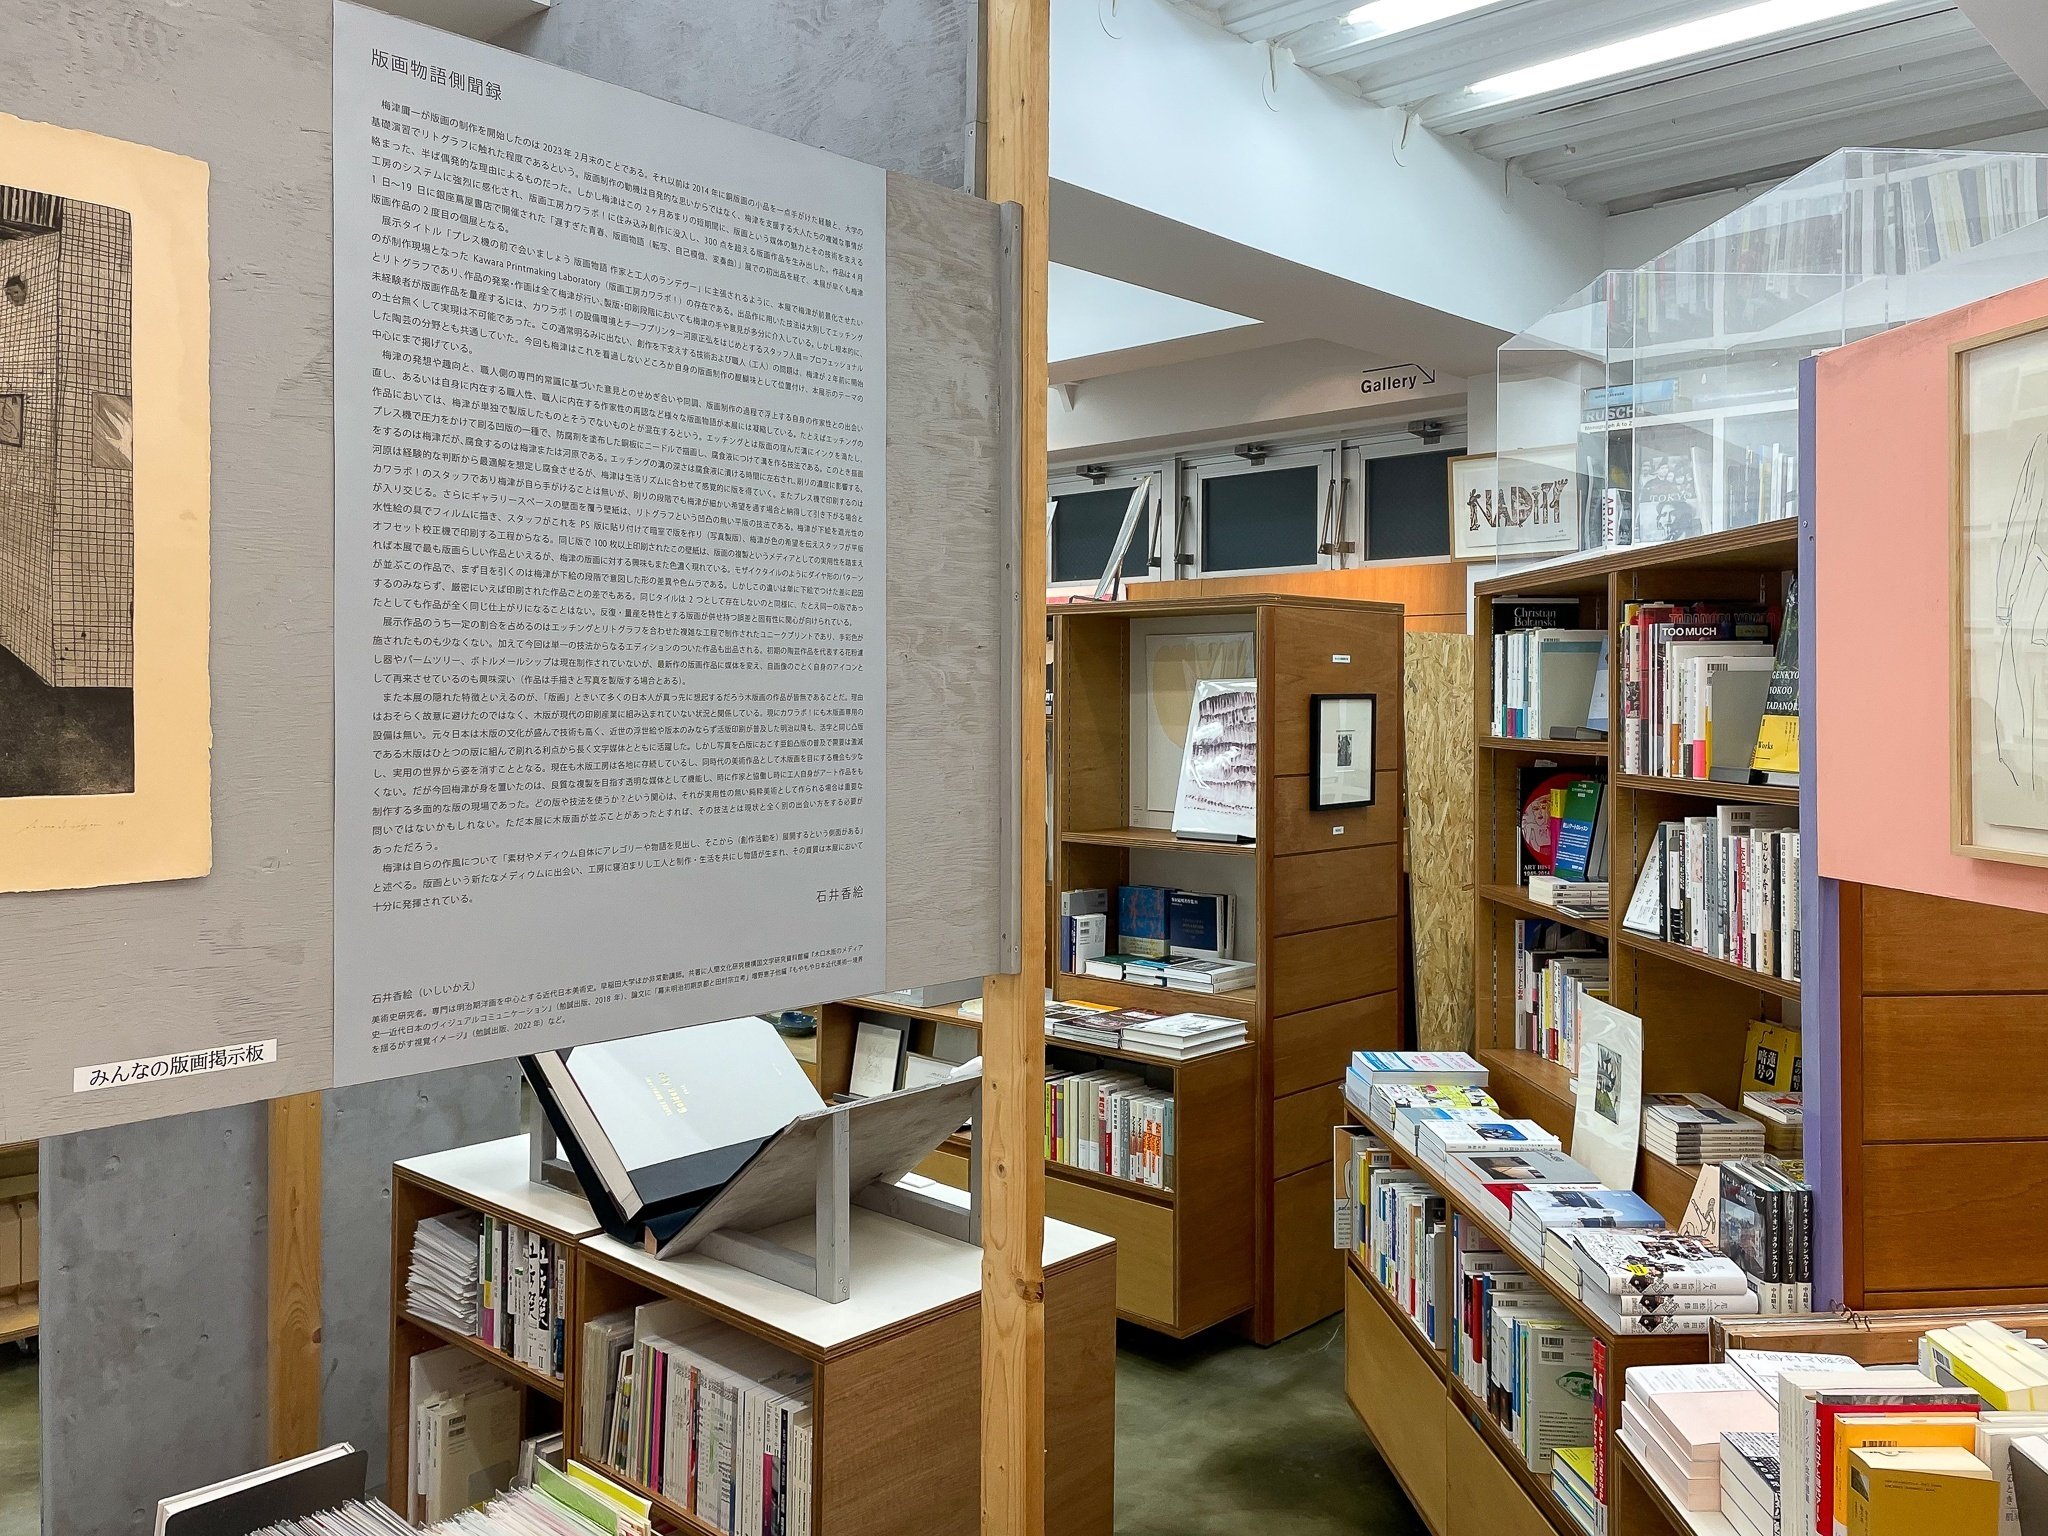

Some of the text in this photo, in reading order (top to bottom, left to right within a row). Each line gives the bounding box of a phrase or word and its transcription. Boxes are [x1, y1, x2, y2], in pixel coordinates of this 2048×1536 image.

[371, 46, 501, 103] 版画物語側聞録
[371, 230, 469, 262] のが制作現場となった
[472, 251, 504, 270] Kawara
[505, 258, 556, 280] Printmaking
[558, 269, 600, 289] Laboratory
[573, 255, 607, 274] 版画物語
[371, 327, 472, 355] 中心にまで掲げている。
[1361, 375, 1417, 393] Gallery
[1513, 606, 1557, 618] Christian
[1513, 616, 1557, 627] Boltanski
[1662, 626, 1717, 636] TOO MUCH
[1771, 670, 1800, 680] GENKYO
[1769, 686, 1793, 695] YOKOO
[1766, 701, 1800, 711] TADANOR
[372, 839, 438, 856] あっただろう。
[372, 892, 472, 913] 十分に発揮されている。
[815, 884, 863, 904] 石井香絵
[372, 979, 474, 1005] 石井香絵（いしいかえ）
[89, 1043, 265, 1087] みんなの版画掲示板
